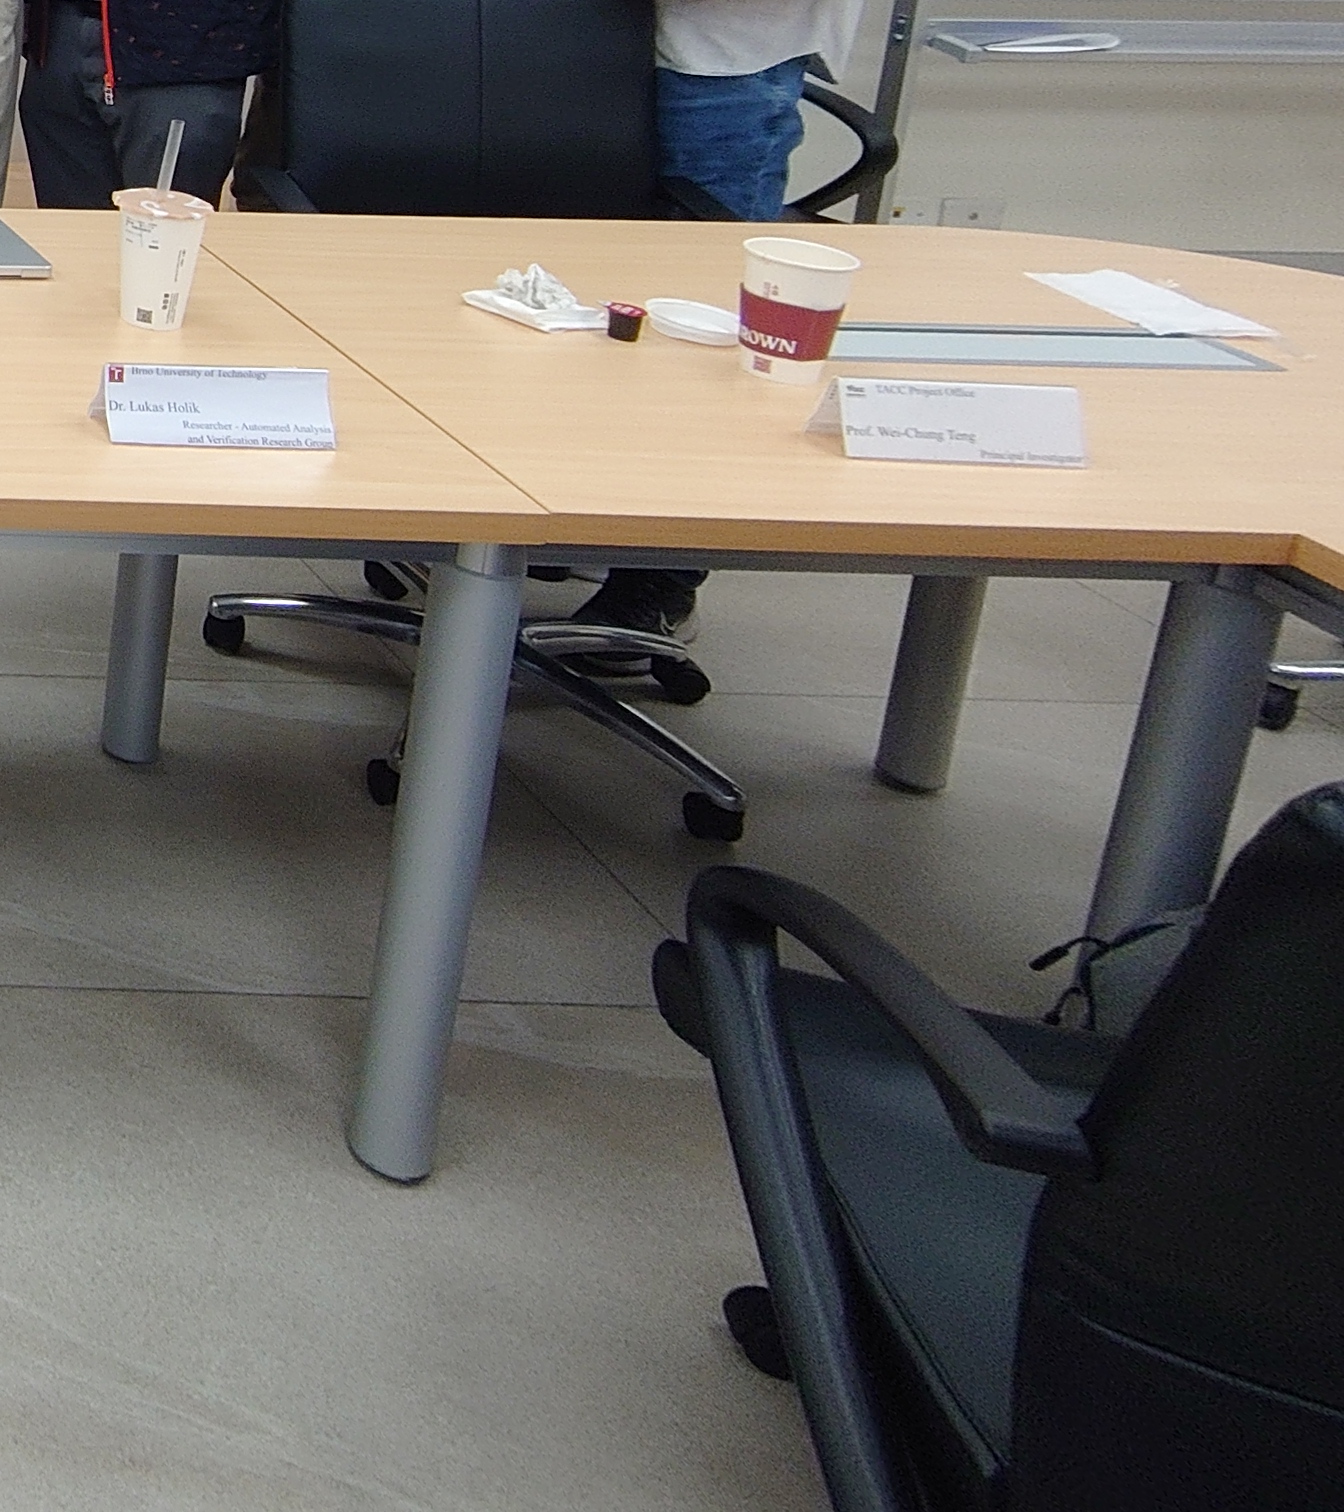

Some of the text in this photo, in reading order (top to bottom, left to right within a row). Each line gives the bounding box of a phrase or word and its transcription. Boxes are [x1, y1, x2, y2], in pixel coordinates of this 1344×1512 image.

[131, 367, 267, 379] Brno University of Technology
[109, 400, 200, 413] Dr. Lukas Holik
[182, 420, 232, 431] Researcher
[241, 422, 291, 433] Automated
[293, 424, 332, 436] Analysis
[187, 435, 204, 444] and
[206, 435, 259, 446] Verification
[261, 436, 302, 447] Research
